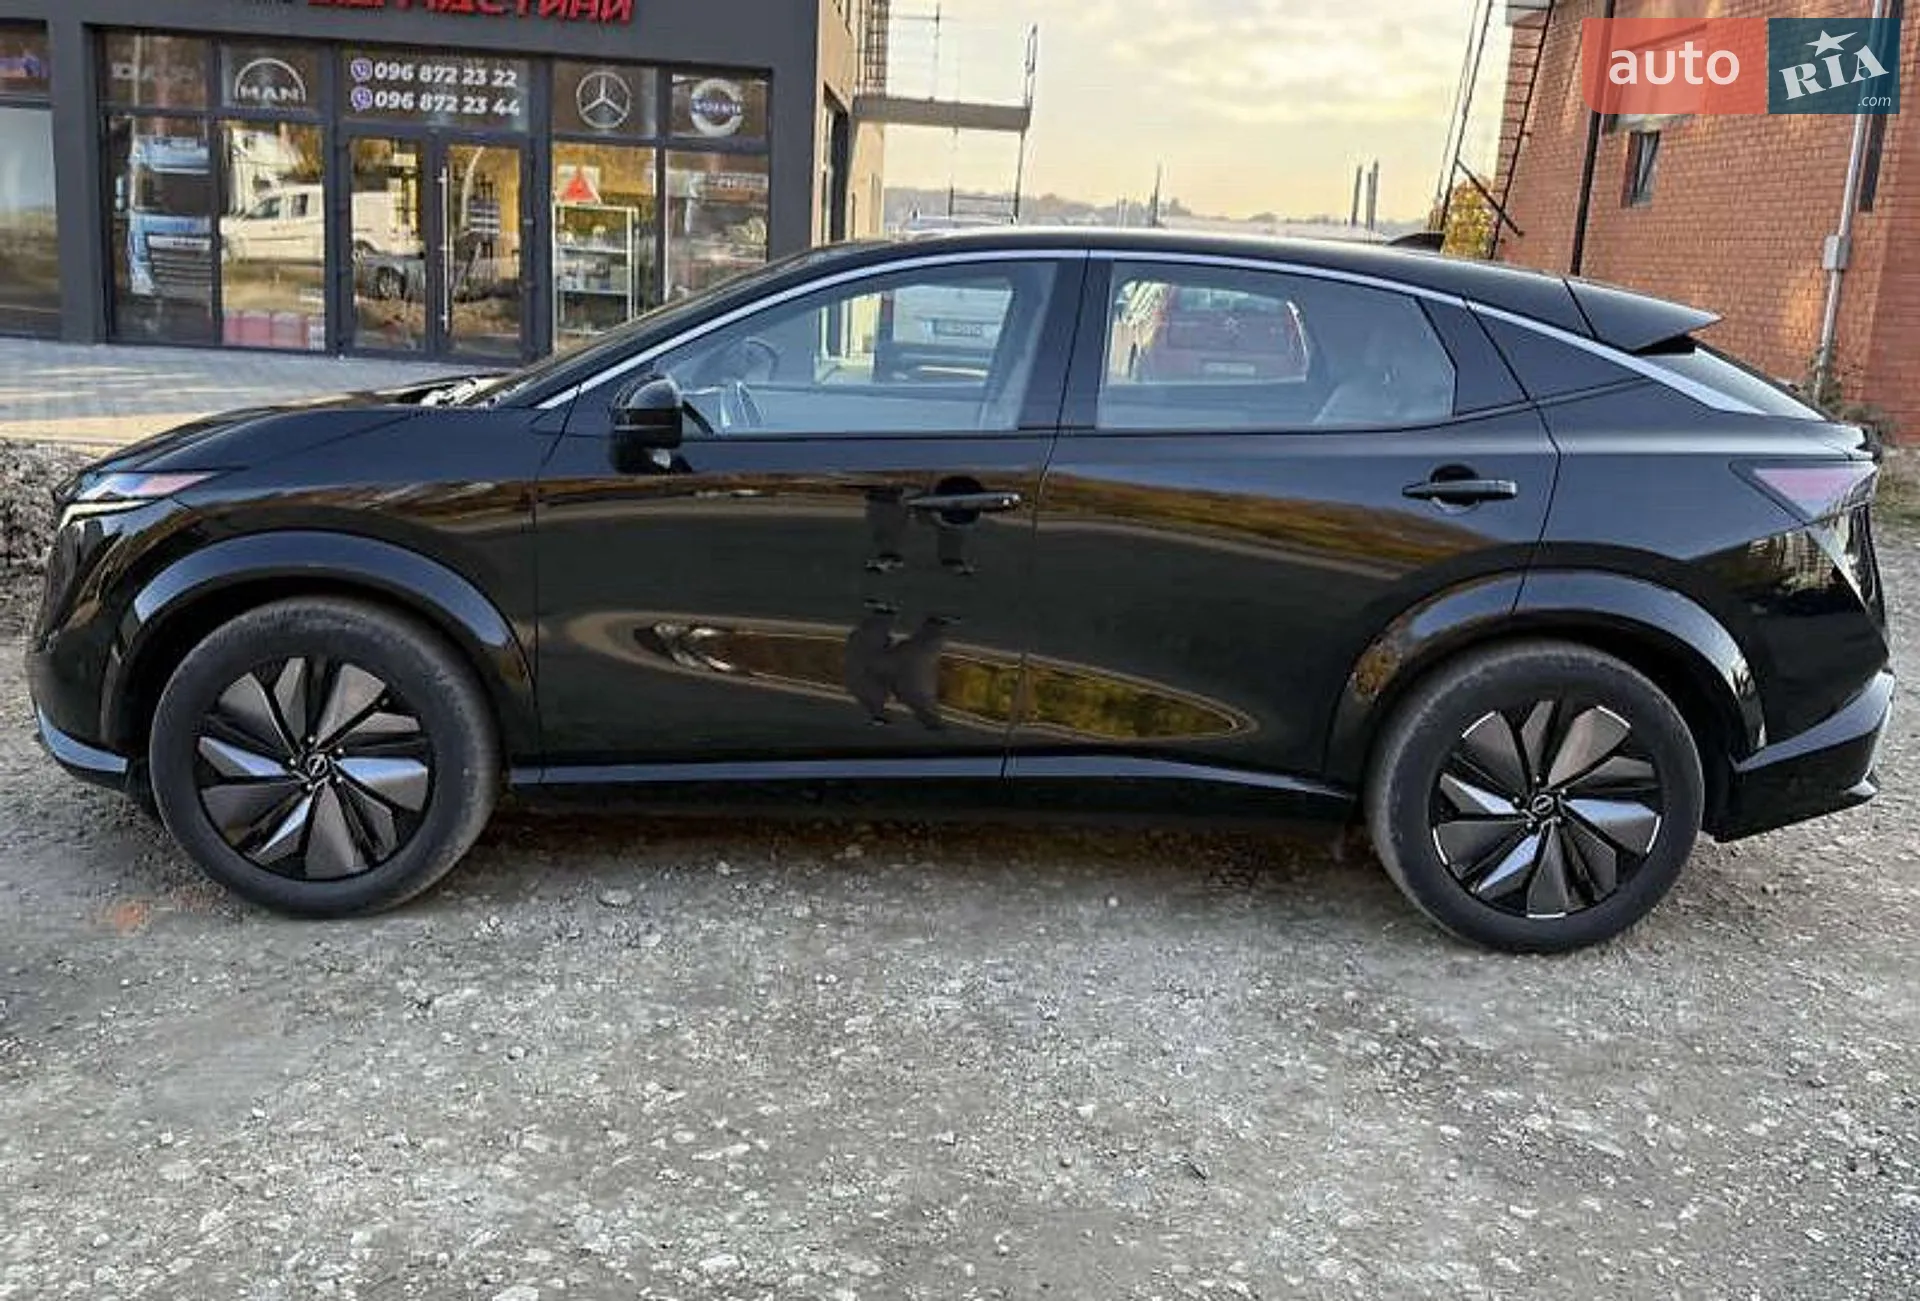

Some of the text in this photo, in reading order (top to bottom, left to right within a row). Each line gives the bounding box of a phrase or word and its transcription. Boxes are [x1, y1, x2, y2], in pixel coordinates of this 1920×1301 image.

[374, 61, 518, 88] 096 872 23 22
[240, 84, 300, 100] MAN
[374, 90, 521, 117] 096 872 23 44
